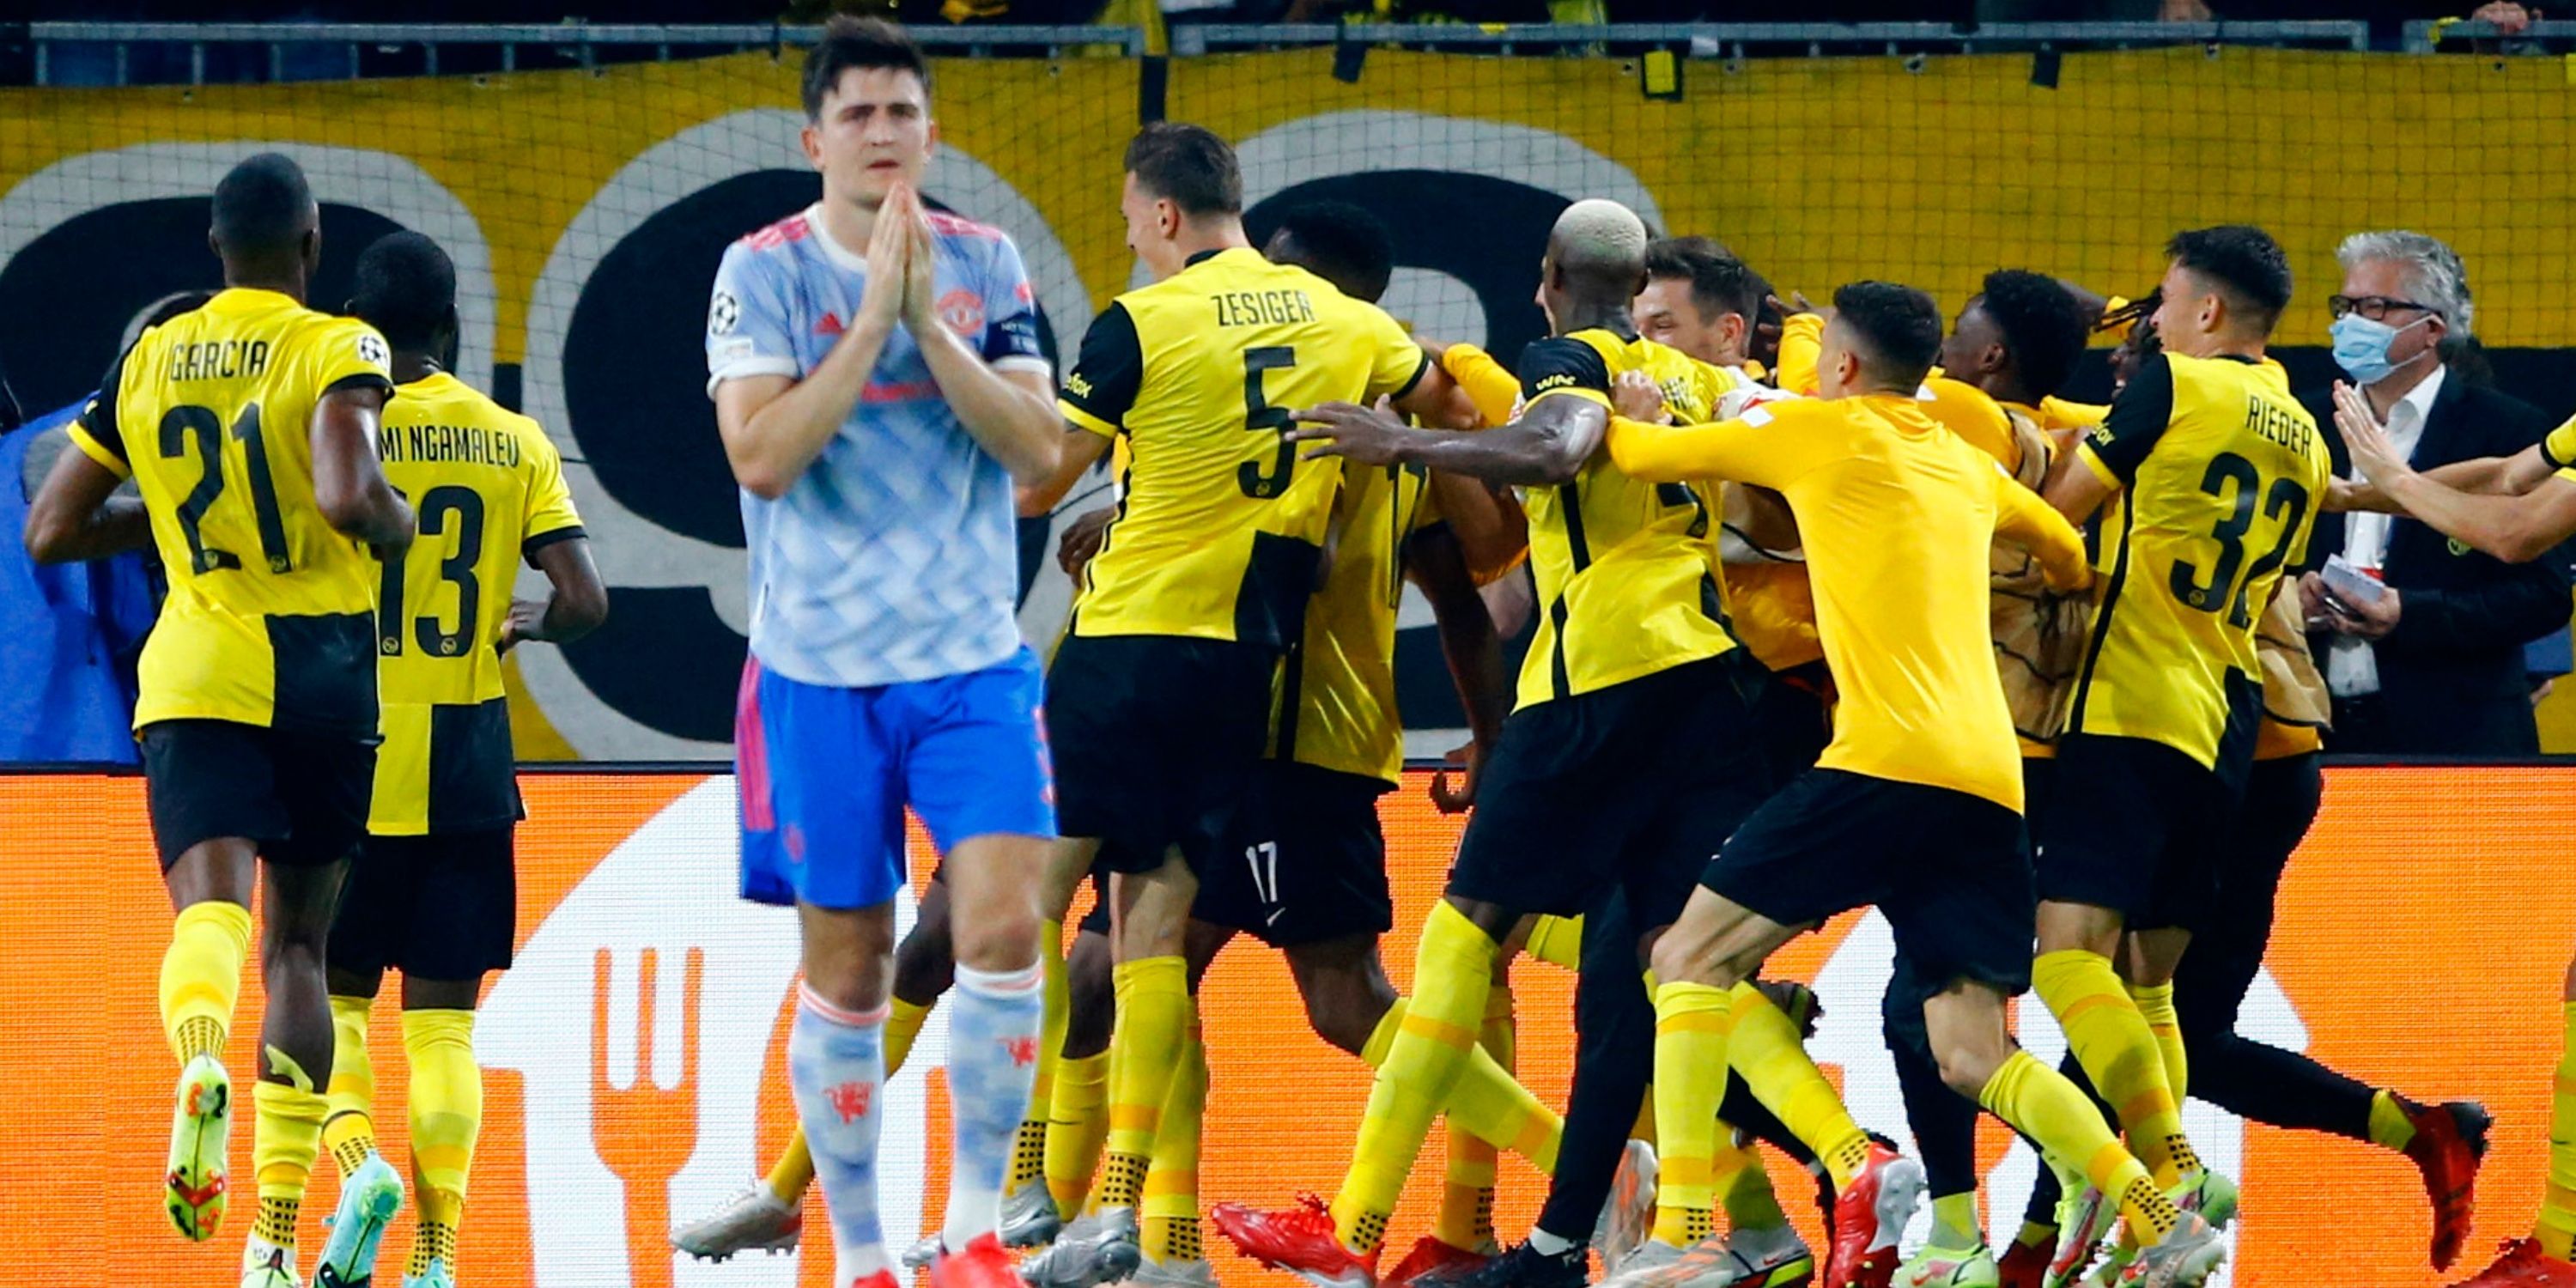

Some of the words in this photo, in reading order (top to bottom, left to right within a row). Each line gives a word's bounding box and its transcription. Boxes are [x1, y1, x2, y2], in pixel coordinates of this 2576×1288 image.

[1211, 290, 1315, 326] ZESIGER
[171, 340, 268, 381] GARCIA
[380, 427, 403, 462] MI
[410, 426, 520, 467] NGAMALEU
[1238, 345, 1296, 499] 5
[2246, 395, 2313, 458] RIEDER
[159, 402, 292, 574] 21
[2170, 452, 2309, 629] 32
[1246, 841, 1278, 903] 17
